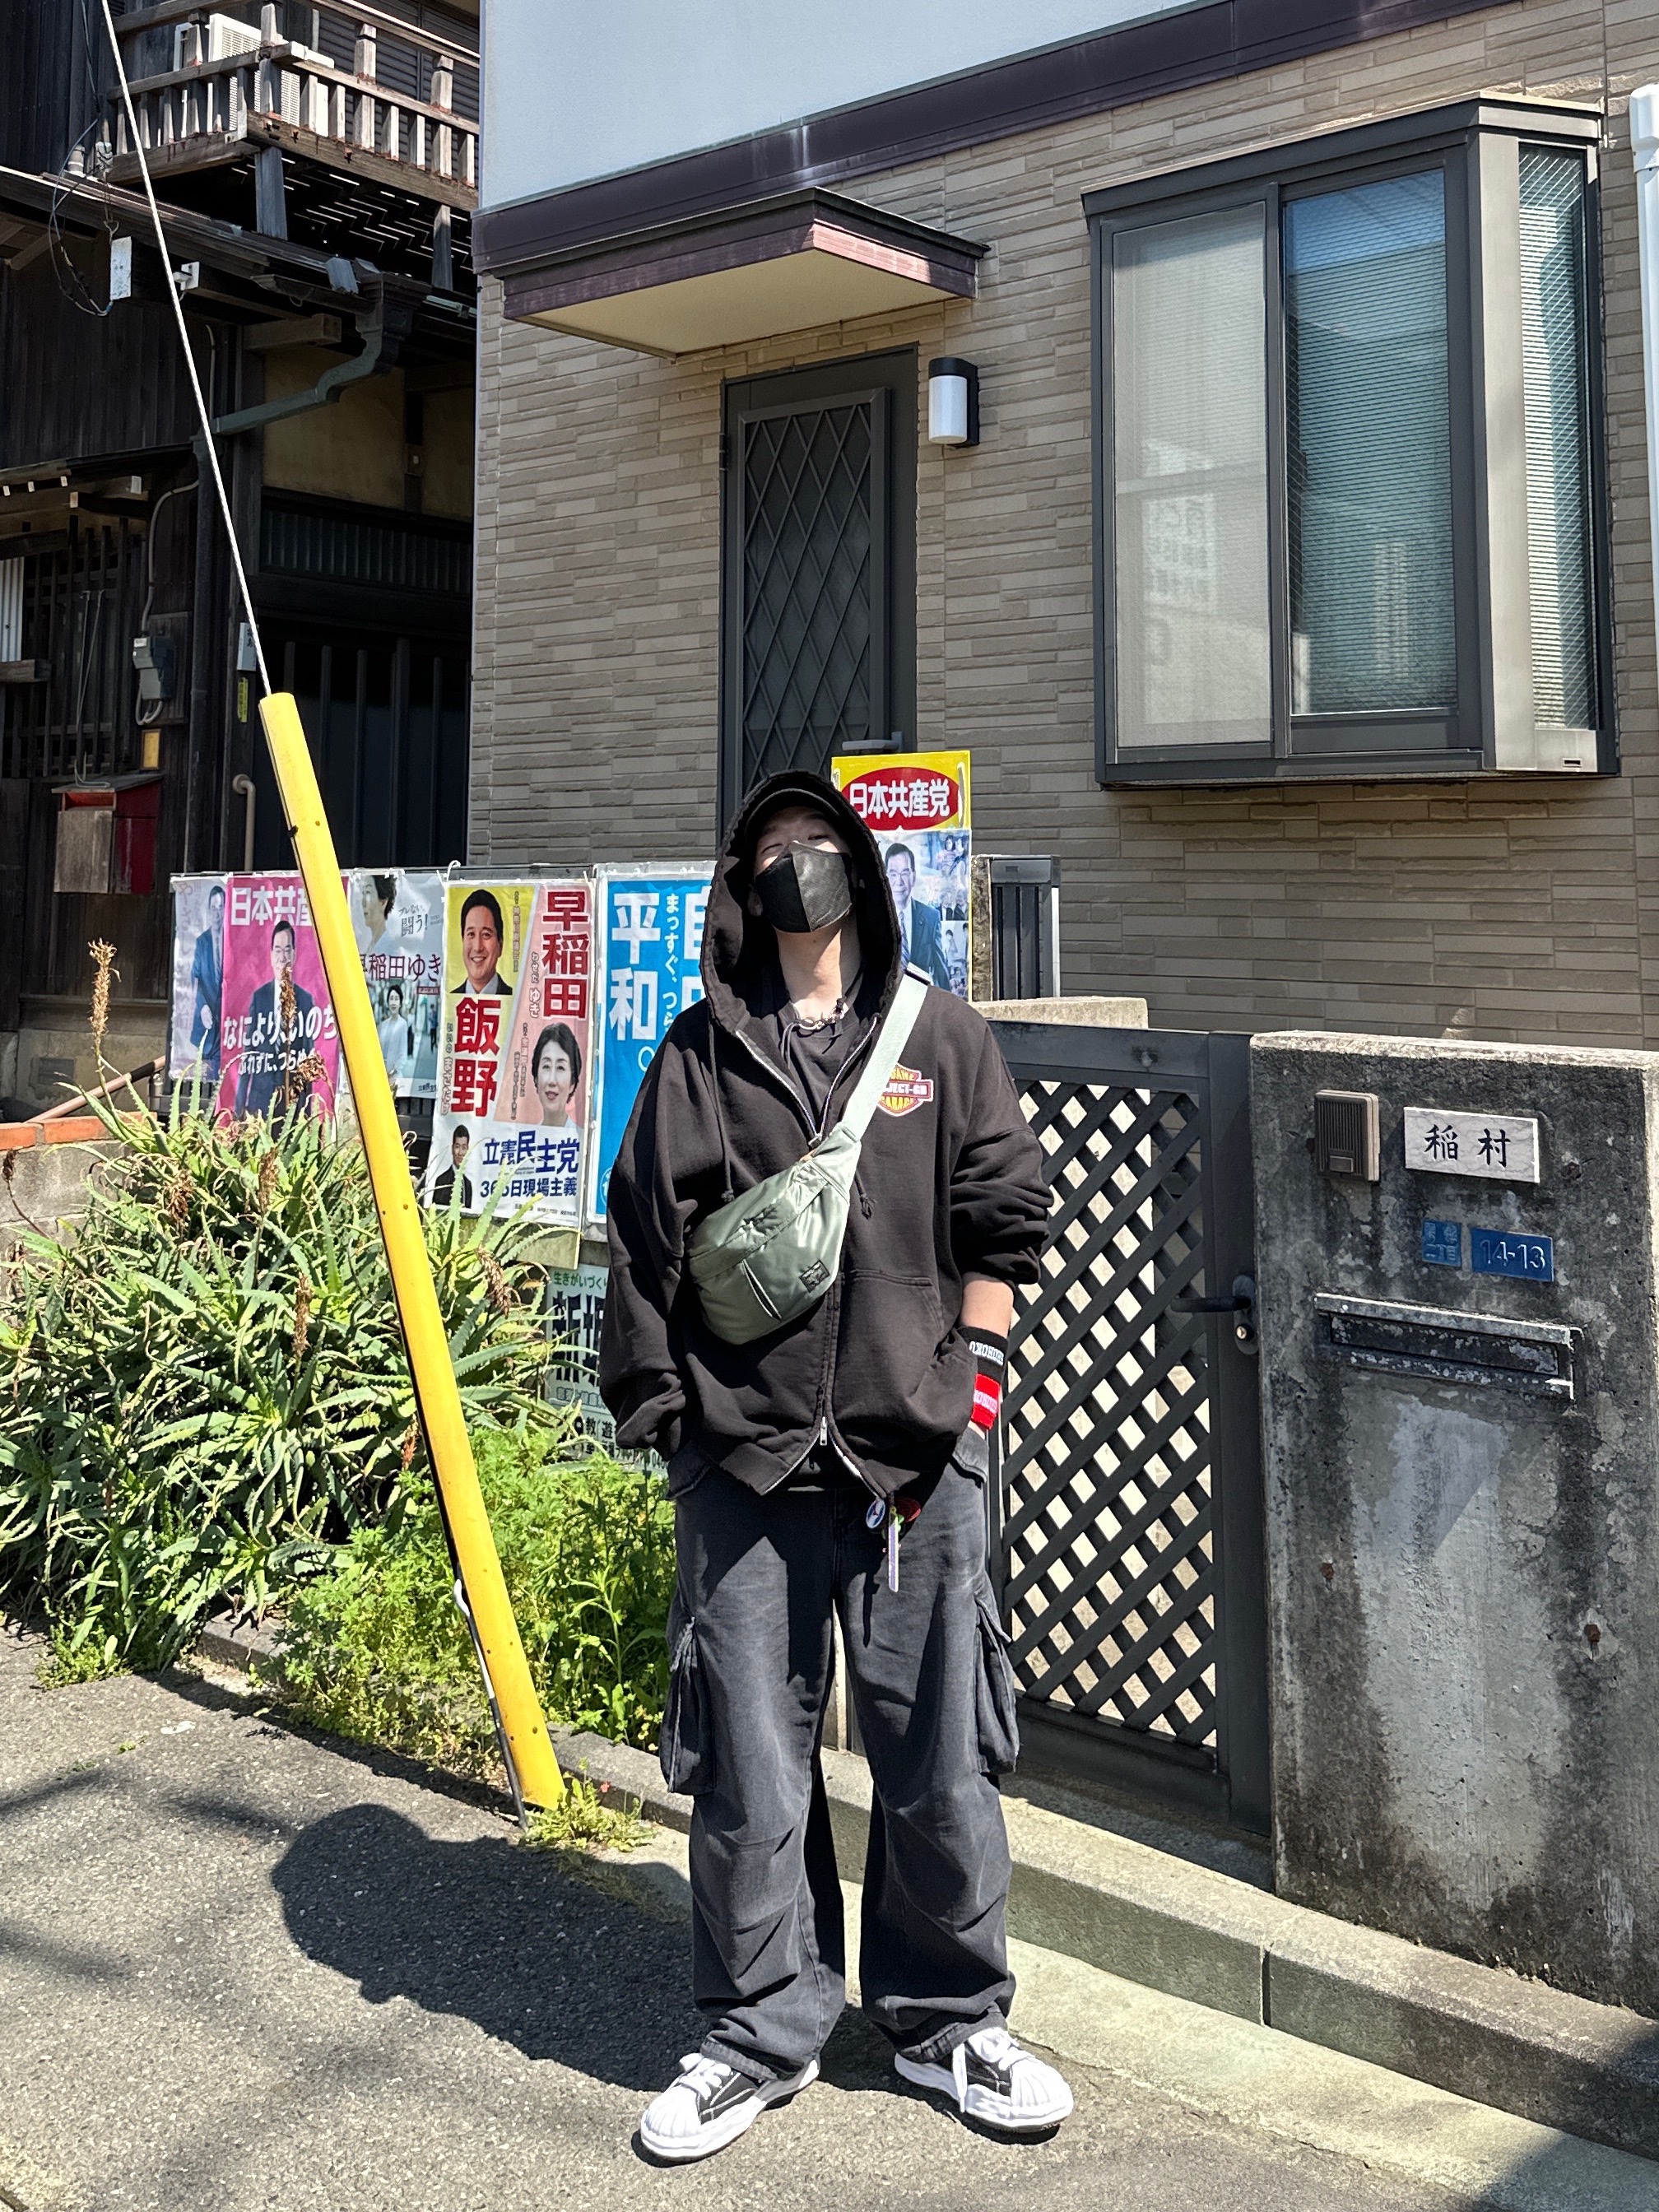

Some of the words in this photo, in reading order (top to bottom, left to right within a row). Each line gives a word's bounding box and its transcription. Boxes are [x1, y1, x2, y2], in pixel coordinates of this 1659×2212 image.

[849, 778, 950, 820] 日本共産党
[542, 891, 589, 1018] 早稲田
[451, 997, 502, 1117] 飯野
[482, 1130, 580, 1174] 立憲民主党
[1424, 1124, 1512, 1168] 稲村
[1481, 1239, 1546, 1271] 14-13
